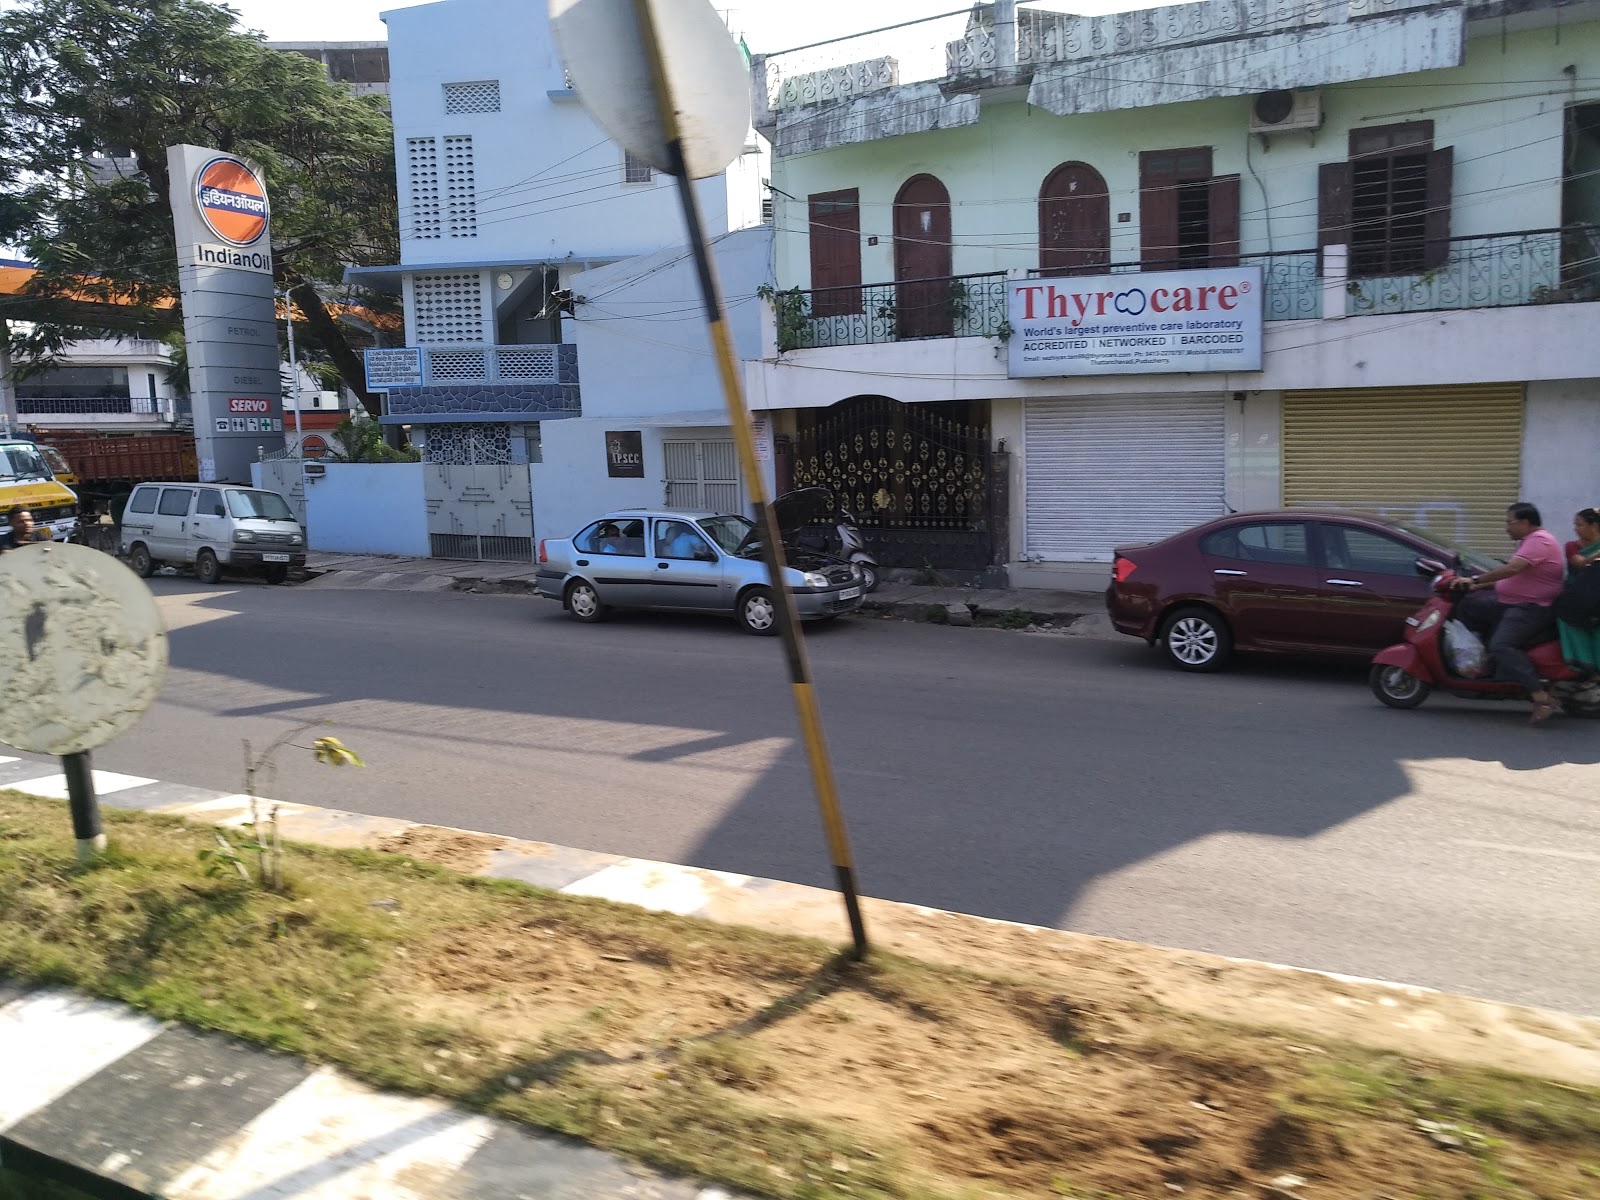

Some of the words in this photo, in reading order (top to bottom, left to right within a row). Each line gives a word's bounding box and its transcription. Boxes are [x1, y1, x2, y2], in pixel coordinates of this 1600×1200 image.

[202, 188, 265, 213] इंडियनऑयल
[198, 245, 270, 270] IndianOil
[227, 327, 261, 336] PETROL
[1024, 326, 1062, 337] World's
[1065, 325, 1100, 336] largest
[1103, 322, 1157, 333] preventive
[1160, 323, 1184, 331] care
[1186, 320, 1243, 330] laboratory
[1023, 341, 1088, 351] ACCREDITED
[1099, 337, 1166, 348] NETWORKED
[1181, 334, 1243, 345] BARCODED
[234, 376, 262, 385] DIESEL
[231, 399, 267, 412] SERVO
